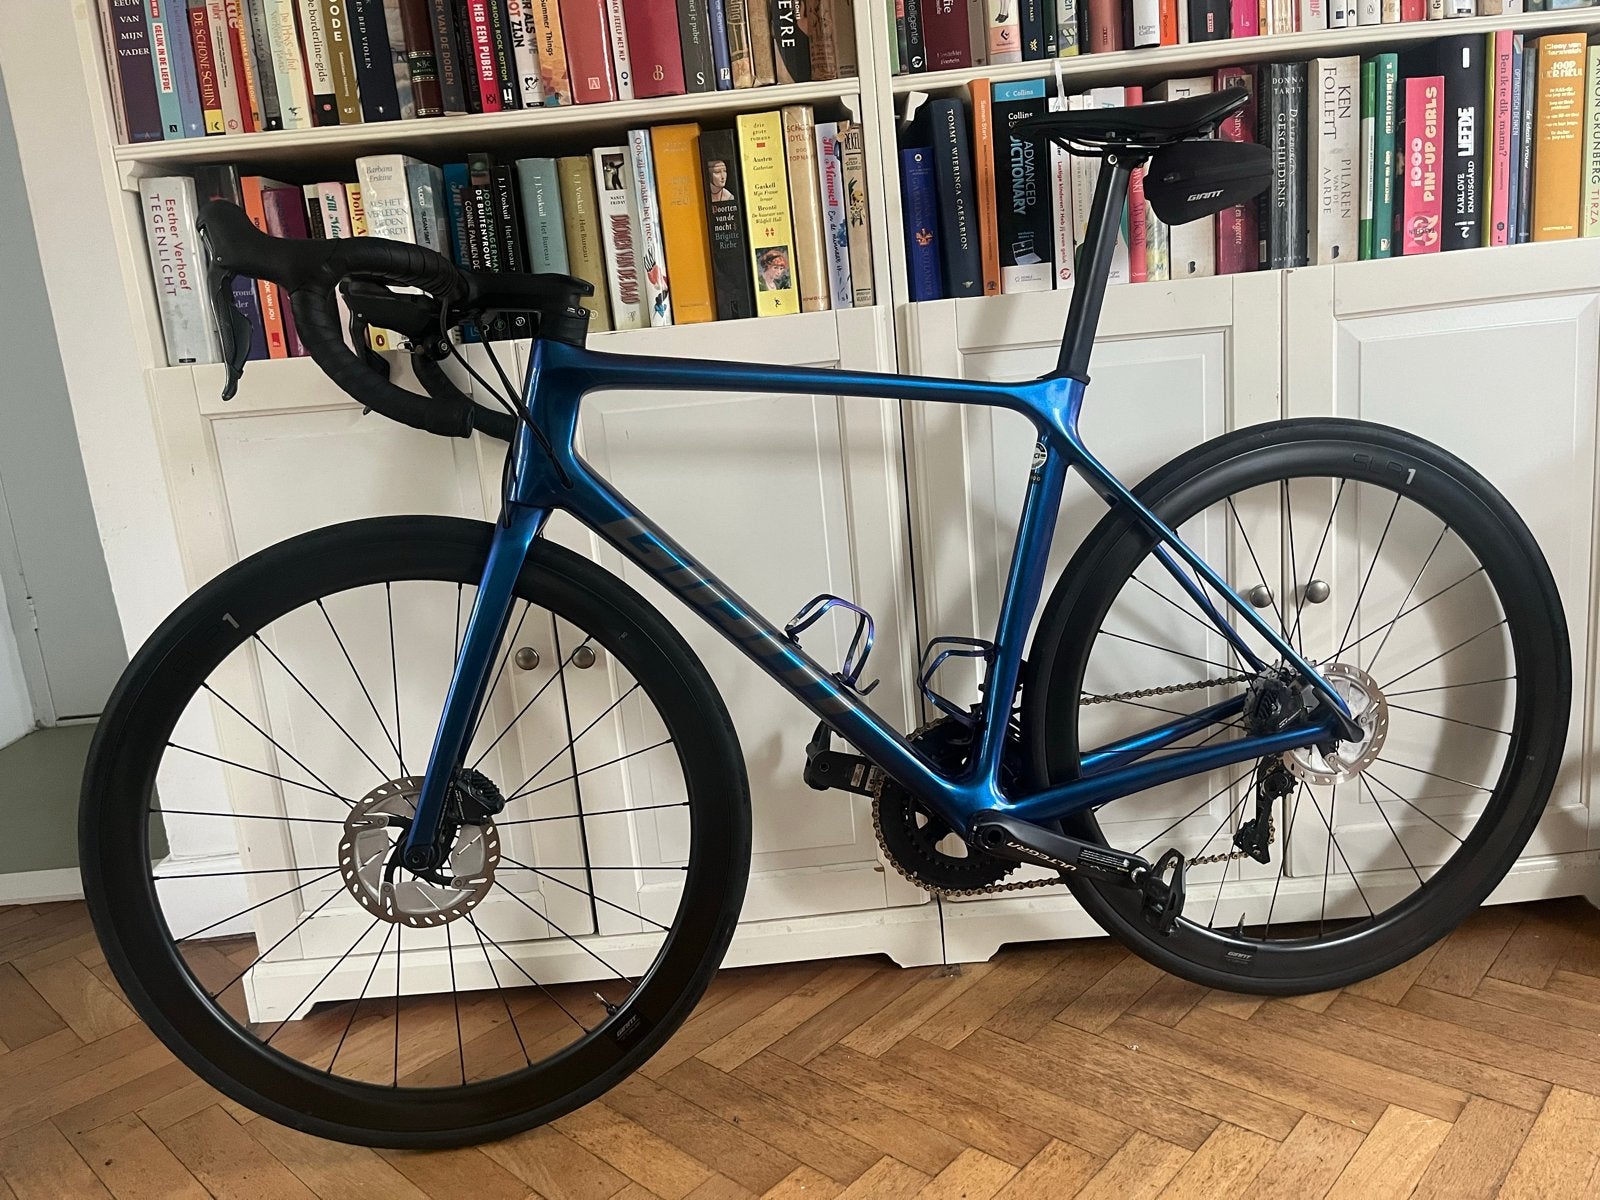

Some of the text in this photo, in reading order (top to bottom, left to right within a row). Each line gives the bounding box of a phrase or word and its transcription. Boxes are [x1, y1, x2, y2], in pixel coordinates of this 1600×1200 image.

[120, 15, 140, 23] VAN
[512, 20, 525, 48] ZIJN
[524, 12, 536, 34] ALS
[541, 0, 554, 56] Summer Things
[614, 16, 622, 36] JEZELF
[689, 22, 700, 44] puber
[778, 0, 796, 48] EYRE
[121, 32, 144, 40] MIJN
[154, 24, 162, 46] GELUK
[310, 9, 328, 82] borderline-gids
[358, 16, 372, 69] BED VIOLEN
[438, 14, 454, 84] VAN DE DODEN
[473, 4, 494, 80] HEB EEN PUBER!
[119, 48, 150, 56] VADER
[159, 57, 167, 66] DE
[192, 12, 216, 106] DE SCHONE SCHIJN
[495, 30, 508, 80] ROCK BOTTOM
[1500, 54, 1510, 73] Ben
[161, 68, 171, 90] LIEFDE
[1272, 76, 1304, 85] DONNA
[1274, 87, 1302, 95] TARTT
[1500, 76, 1509, 86] ik
[1500, 87, 1508, 96] te
[1324, 67, 1337, 140] FOLLETT
[1338, 85, 1351, 120] KEN
[1498, 98, 1508, 119] dik,
[1526, 110, 1533, 120] de
[1233, 110, 1246, 138] Nancy
[1458, 106, 1475, 156] LIEFDE
[1498, 120, 1508, 156] mama?
[1524, 121, 1532, 144] ideale
[822, 136, 833, 157] Jill
[1424, 86, 1438, 202] PIN-UP GIRLS
[366, 166, 393, 174] Barbara
[1023, 141, 1036, 206] ADVANCED
[1277, 113, 1286, 208] GESCHIEDENIS
[1410, 137, 1423, 188] 1000
[370, 174, 393, 182] Erskine
[634, 137, 652, 222] Ook zij maakte het
[754, 182, 776, 190] Gaskell
[825, 159, 838, 207] Mansell
[948, 109, 968, 250] TOMMY WIERINGA CAESARION
[1323, 167, 1332, 214] AARDE
[1341, 158, 1351, 219] PILAREN
[1466, 160, 1474, 212] KNAUSGÅRD
[352, 192, 364, 222] Dolly
[385, 198, 403, 207] HET
[712, 204, 738, 214] Poorten
[1187, 190, 1224, 202] GIANT
[1333, 192, 1338, 204] DE
[1456, 190, 1464, 213] KARL
[1590, 190, 1600, 226] TIRZA
[368, 208, 408, 218] VERLEDEN
[536, 189, 550, 262] Voskuil Het Bureau
[575, 186, 584, 214] Voskuil
[580, 234, 589, 258] Bureau
[714, 222, 732, 232] nacht
[1232, 209, 1244, 245] en begeerte
[465, 200, 480, 270] CONNIE PALMEN DE
[475, 189, 492, 268] DE BUITENVROUW
[483, 189, 499, 272] JOOST ZWAGERMAN
[500, 191, 510, 220] Voskuil
[506, 240, 515, 266] Bureau
[715, 231, 740, 242] Brigitte
[150, 194, 177, 296] TEGENLICHT
[165, 198, 192, 291] Esther Verhoef
[610, 214, 640, 304] DROMEN VAN DE DAAD
[720, 240, 738, 250] Riebe
[1406, 468, 1416, 485] 1
[222, 612, 240, 630] 1
[1007, 840, 1077, 872] ULTEGRA
